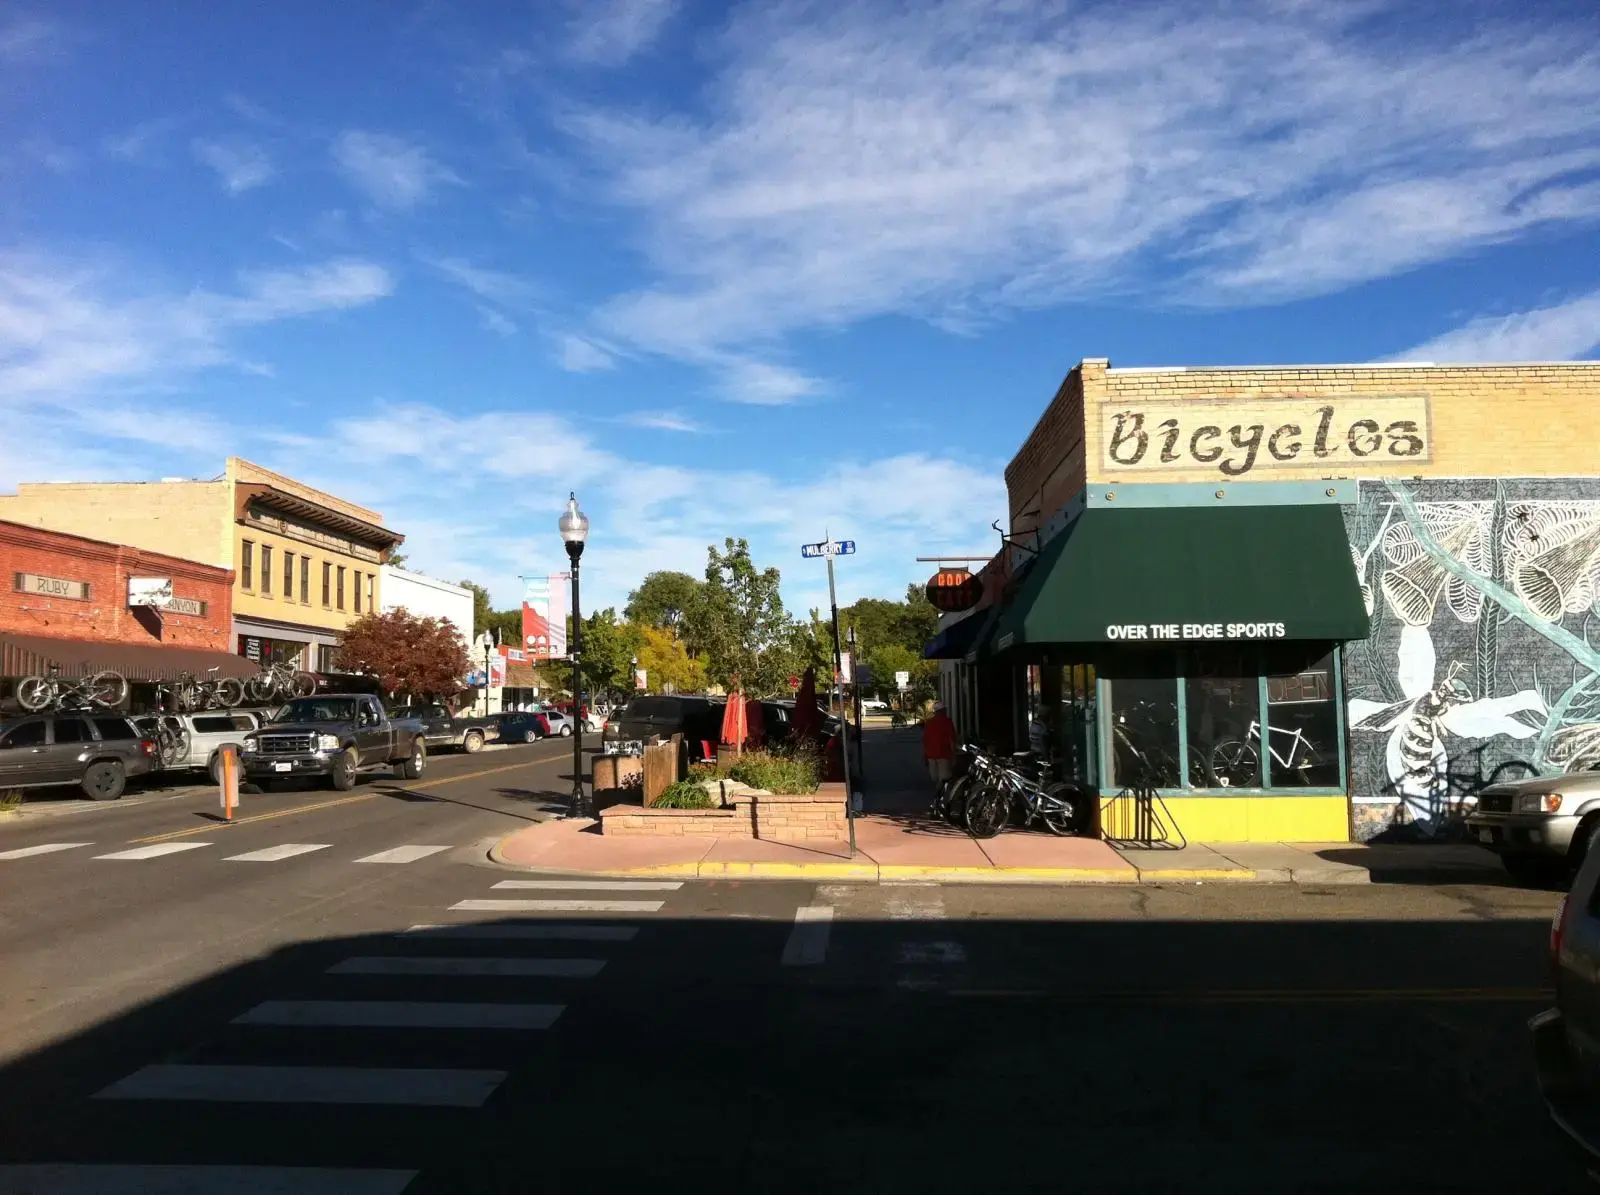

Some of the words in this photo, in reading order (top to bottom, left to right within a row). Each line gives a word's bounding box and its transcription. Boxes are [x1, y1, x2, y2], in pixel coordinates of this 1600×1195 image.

[1109, 405, 1424, 475] Bicycles
[806, 543, 842, 556] MULBERRY
[37, 578, 69, 595] RUBY
[1107, 625, 1148, 639] OVER
[1150, 624, 1180, 639] THE
[1182, 624, 1223, 638] EDGE
[1226, 622, 1285, 638] SPORTS
[1268, 674, 1328, 700] OPEN
